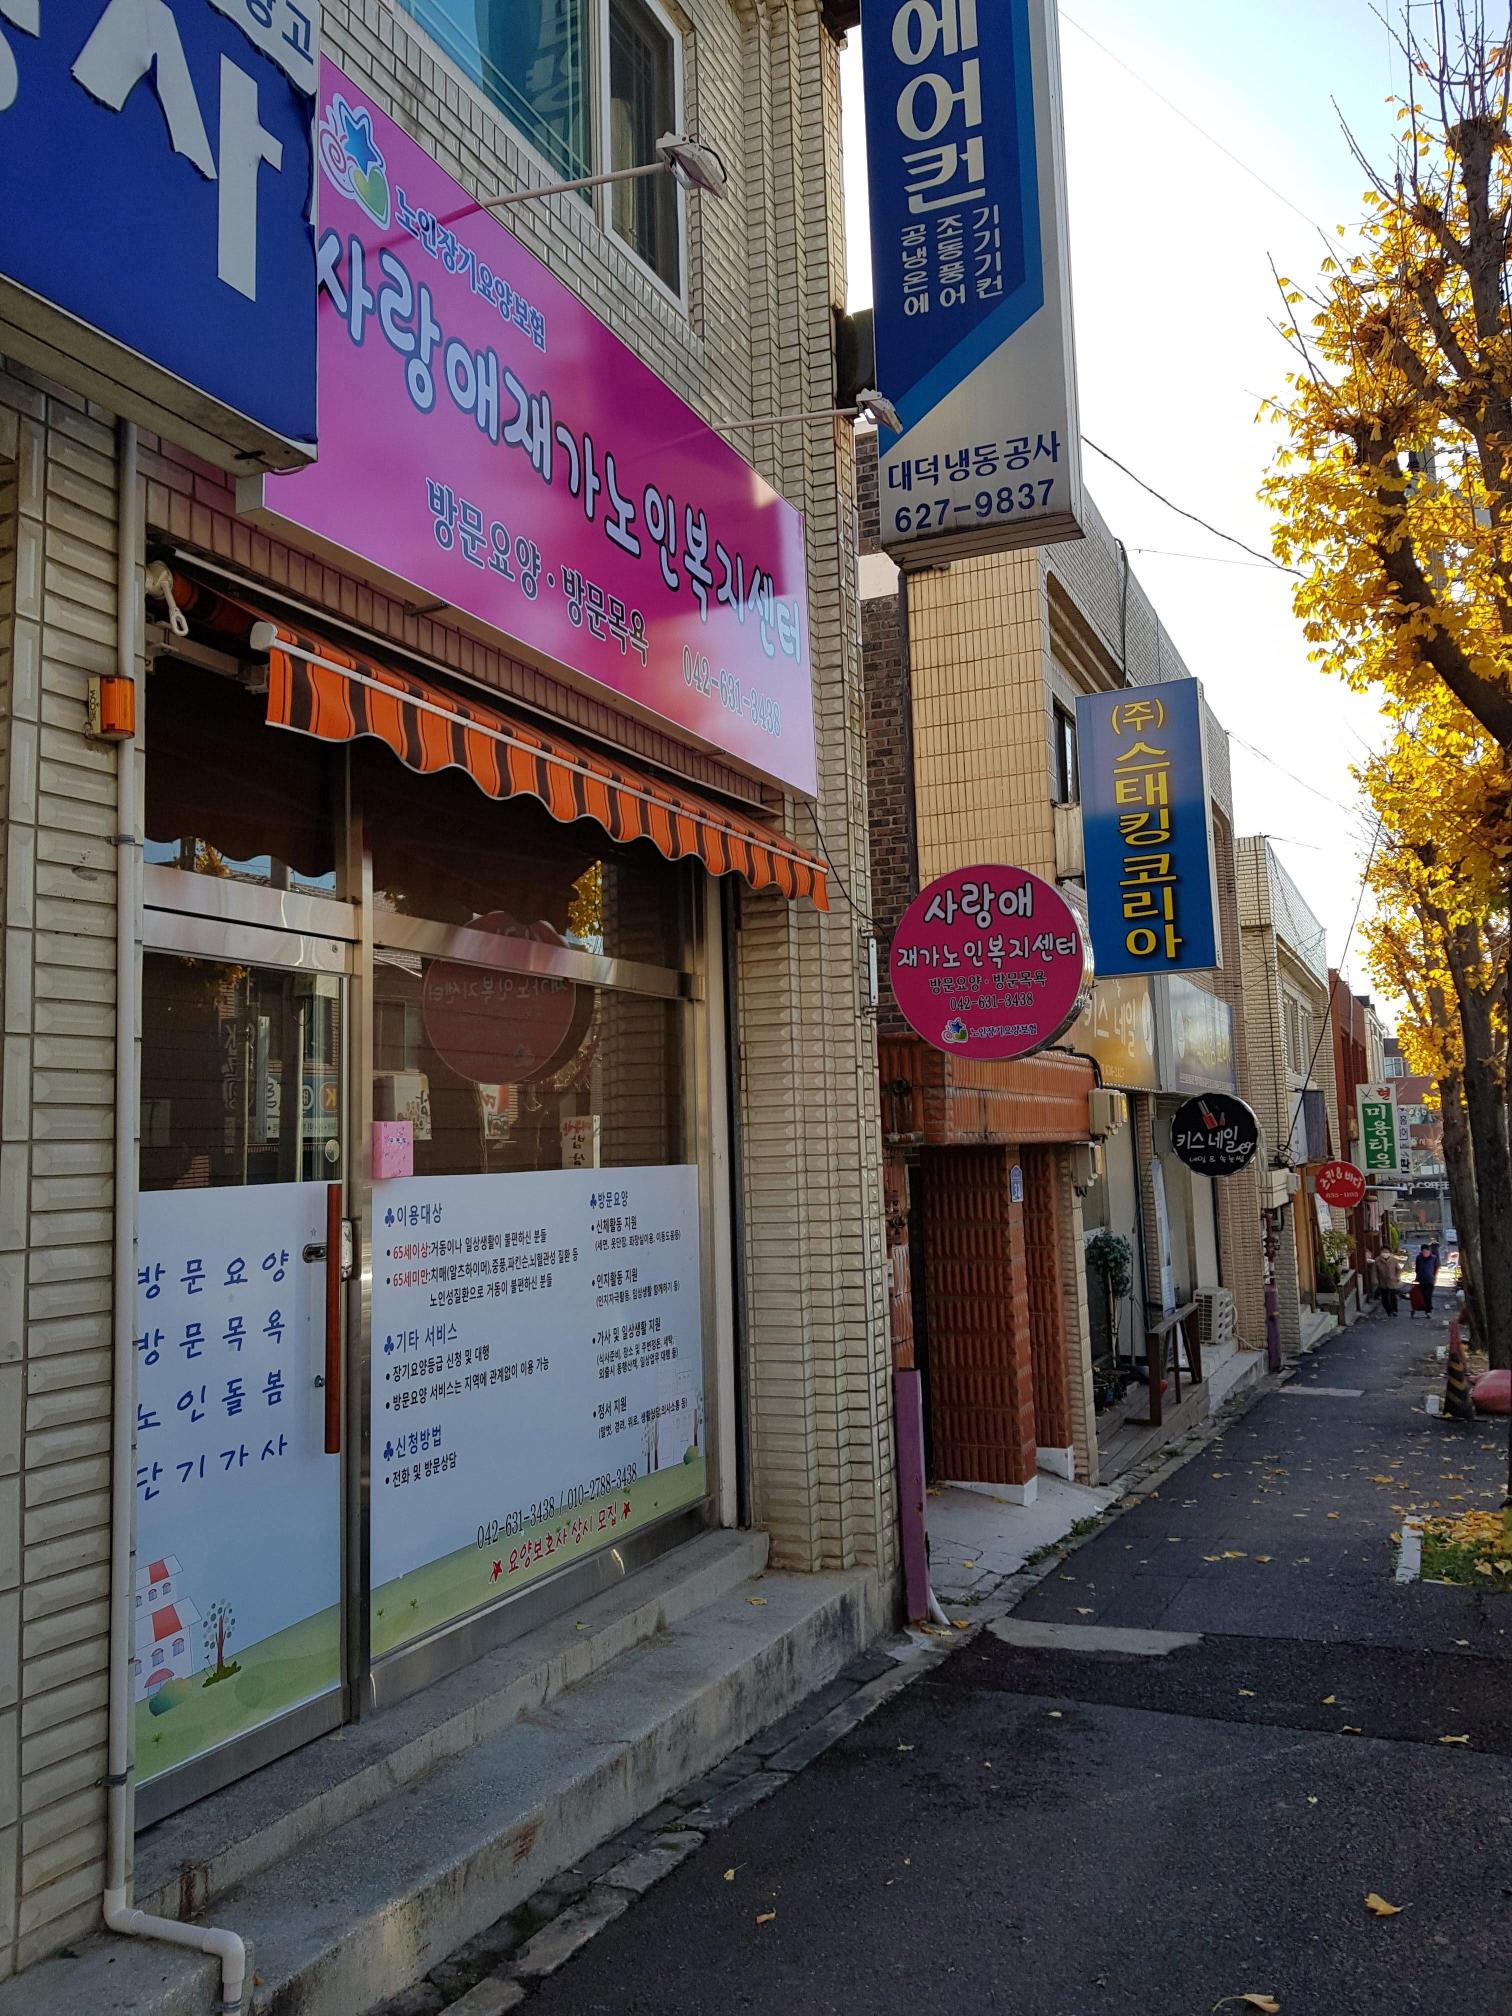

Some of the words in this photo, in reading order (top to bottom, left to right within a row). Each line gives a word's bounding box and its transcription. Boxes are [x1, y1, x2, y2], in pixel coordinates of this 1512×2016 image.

[891, 0, 986, 214] 에어컨
[395, 185, 547, 353] 노인장기요양보험
[888, 430, 1061, 492] 대덕냉동공사
[895, 478, 1055, 533] 627-9837
[682, 644, 783, 739] 042-631-3438
[1111, 698, 1164, 735] (주)
[1113, 741, 1183, 960] 스태킹코리아
[924, 880, 1034, 929] 사랑애
[897, 932, 1077, 970] 재가노인복지센터
[949, 992, 1034, 1011] 042-631-3438
[969, 1023, 1038, 1039] 노인장기요양보험
[1176, 1130, 1205, 1150] 키스
[1208, 1125, 1243, 1153] 네일
[397, 1203, 443, 1227] 이용대상
[597, 1190, 628, 1209] 방문요양
[465, 1233, 502, 1252] 일상생활이
[504, 1230, 532, 1248] 불편하신
[533, 1228, 548, 1244] 분들
[596, 1217, 622, 1234] 신체활동
[624, 1215, 637, 1231] 지원
[572, 1247, 578, 1262] 등
[137, 1250, 290, 1299] 방문요양
[429, 1285, 484, 1307] 노인성질환으로
[487, 1279, 508, 1299] 거동이
[510, 1276, 538, 1294] 불편하신
[539, 1272, 553, 1288] 분들
[596, 1269, 623, 1289] 인지활동
[625, 1267, 638, 1284] 지원
[137, 1309, 286, 1366] 방문목욕
[396, 1328, 420, 1353] 기타
[424, 1322, 458, 1347] 서비스
[597, 1330, 611, 1346] 가사
[613, 1328, 620, 1343] 및
[621, 1320, 647, 1340] 일상생활
[648, 1316, 661, 1333] 지원
[392, 1355, 444, 1383] 장기요양등급
[446, 1351, 462, 1369] 신청
[464, 1347, 472, 1364] 및
[474, 1343, 490, 1361] 대행
[137, 1369, 286, 1431] 노인돌봄
[392, 1387, 427, 1411] 방문요양
[430, 1379, 462, 1401] 서비스는
[464, 1373, 487, 1391] 지역에
[489, 1363, 518, 1385] 관계없이
[520, 1359, 534, 1376] 이용
[536, 1356, 550, 1371] 가능
[597, 1400, 612, 1419] 정서
[614, 1395, 627, 1413] 지원
[395, 1424, 442, 1458] 신청방법
[392, 1467, 410, 1488] 전화
[413, 1463, 421, 1481] 및
[424, 1451, 457, 1477] 방문상담
[477, 1496, 556, 1550] 042-631-3438
[567, 1462, 637, 1511] 010-2788-3438
[508, 1528, 567, 1574] 요양보호사
[571, 1514, 593, 1545] 상시
[598, 1501, 617, 1532] 모집
